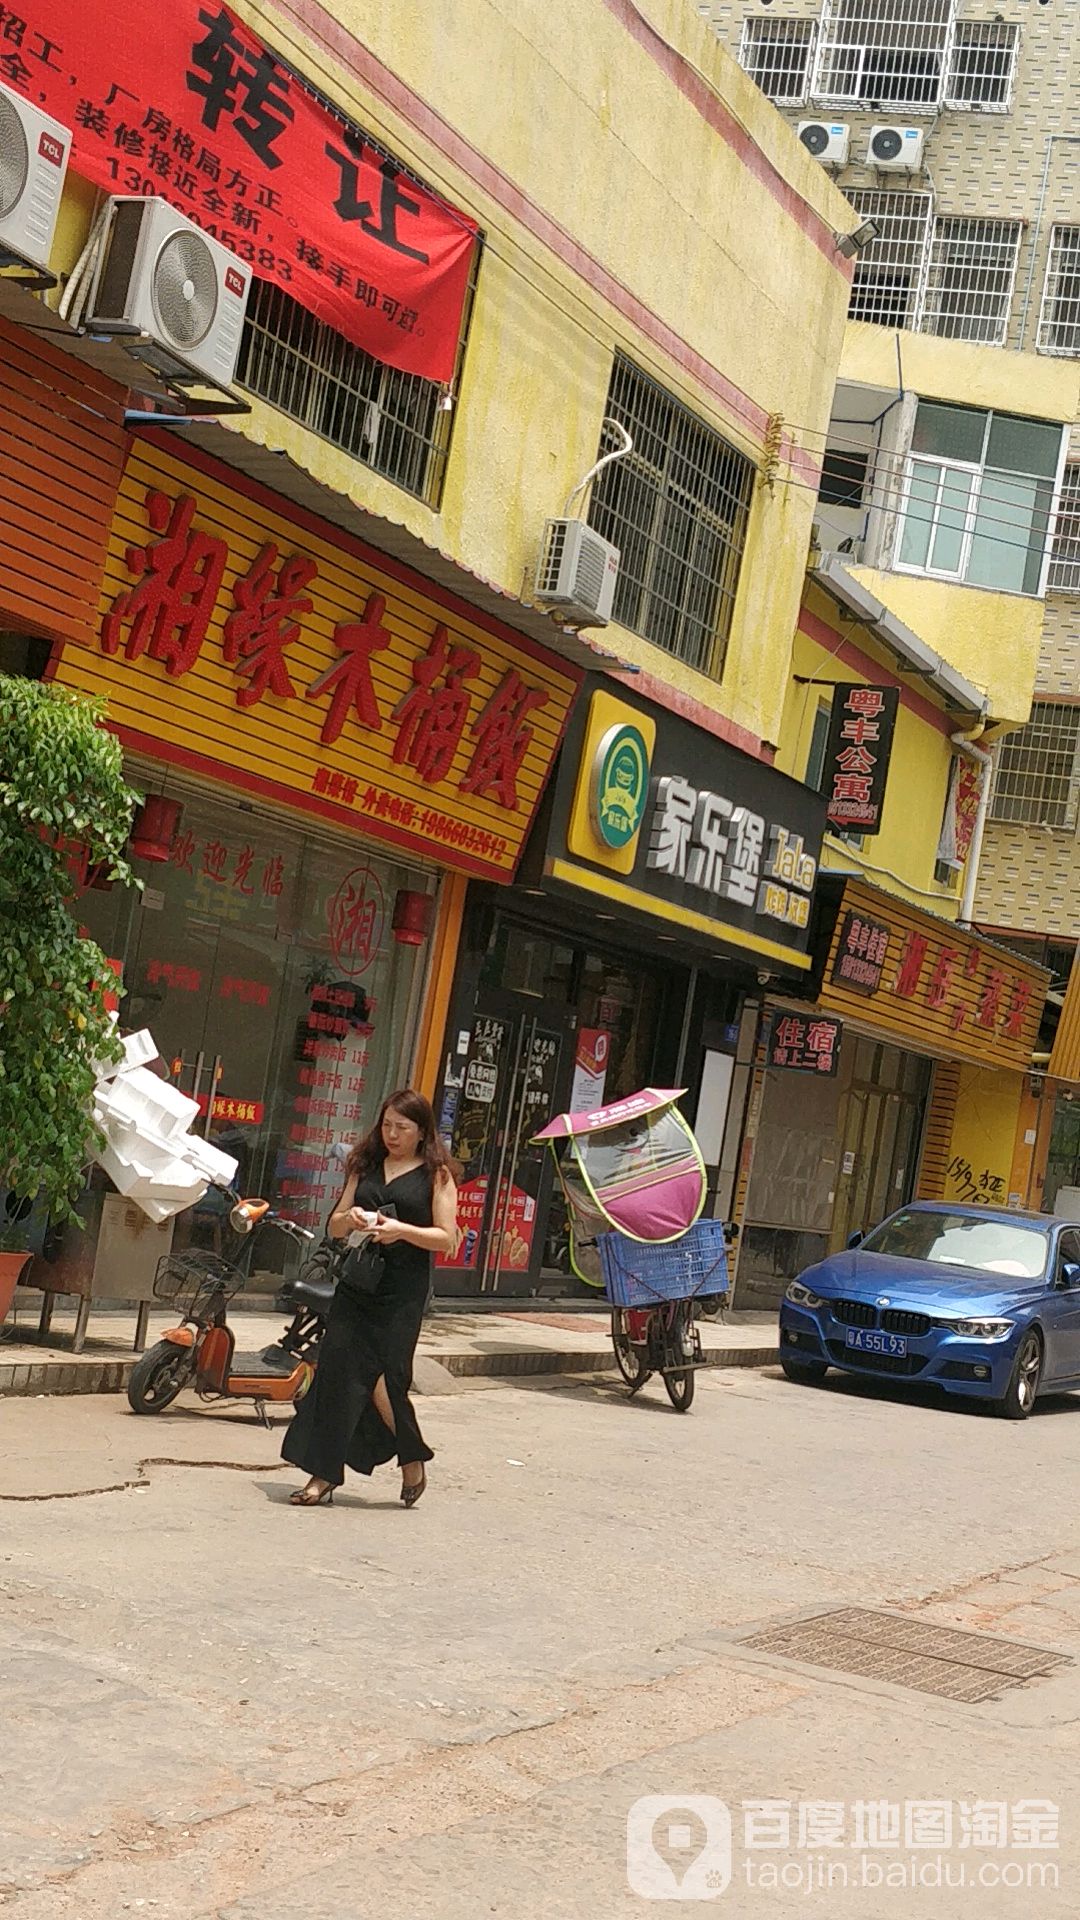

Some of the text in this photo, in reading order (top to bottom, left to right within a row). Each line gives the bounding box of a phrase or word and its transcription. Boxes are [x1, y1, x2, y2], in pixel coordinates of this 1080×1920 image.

[42, 138, 62, 161] TCL
[186, 2, 430, 266] 转让
[227, 272, 244, 292] TCL
[832, 689, 885, 803] 粤丰公寓
[171, 829, 285, 897] 欢迎光临
[646, 774, 765, 907] 家乐堡
[776, 1016, 838, 1054] 住宿
